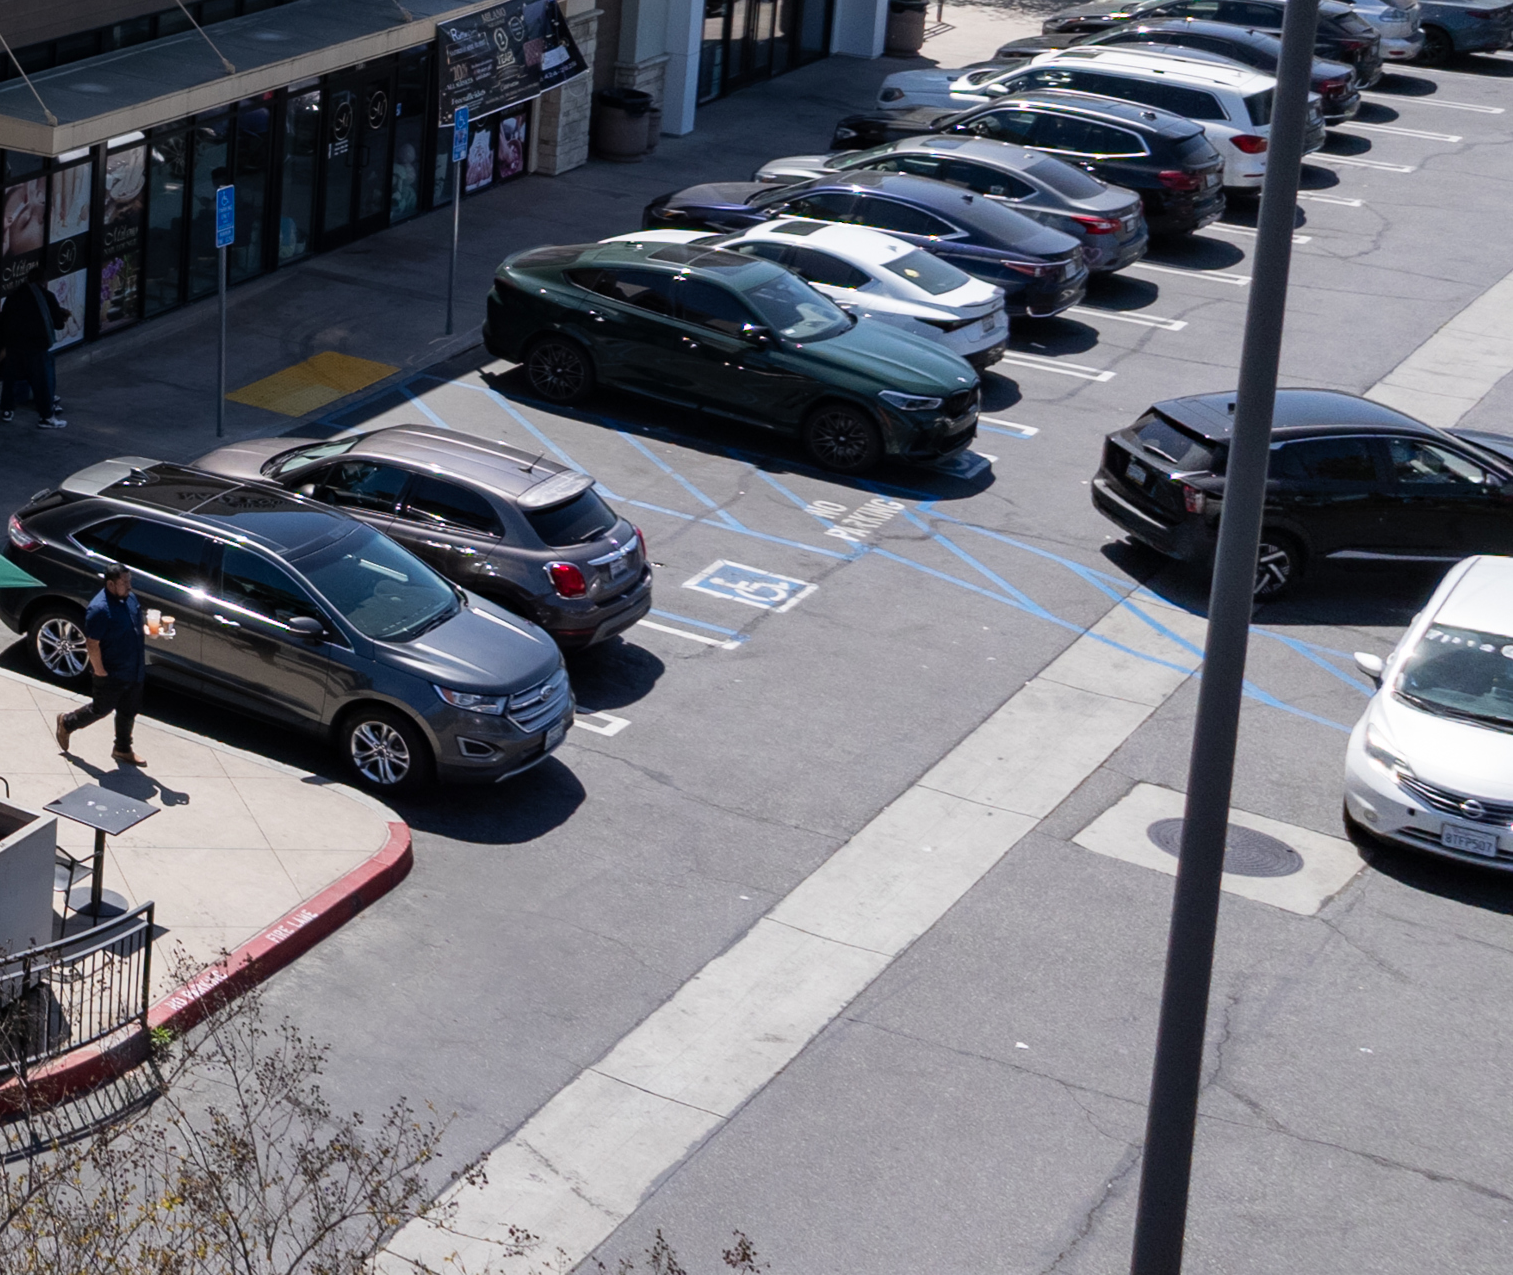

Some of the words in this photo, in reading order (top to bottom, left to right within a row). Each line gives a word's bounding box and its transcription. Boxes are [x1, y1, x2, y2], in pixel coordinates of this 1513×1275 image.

[804, 500, 848, 519] NO
[824, 498, 905, 542] PARKING
[265, 924, 295, 944] FIRE
[287, 909, 319, 929] LANE
